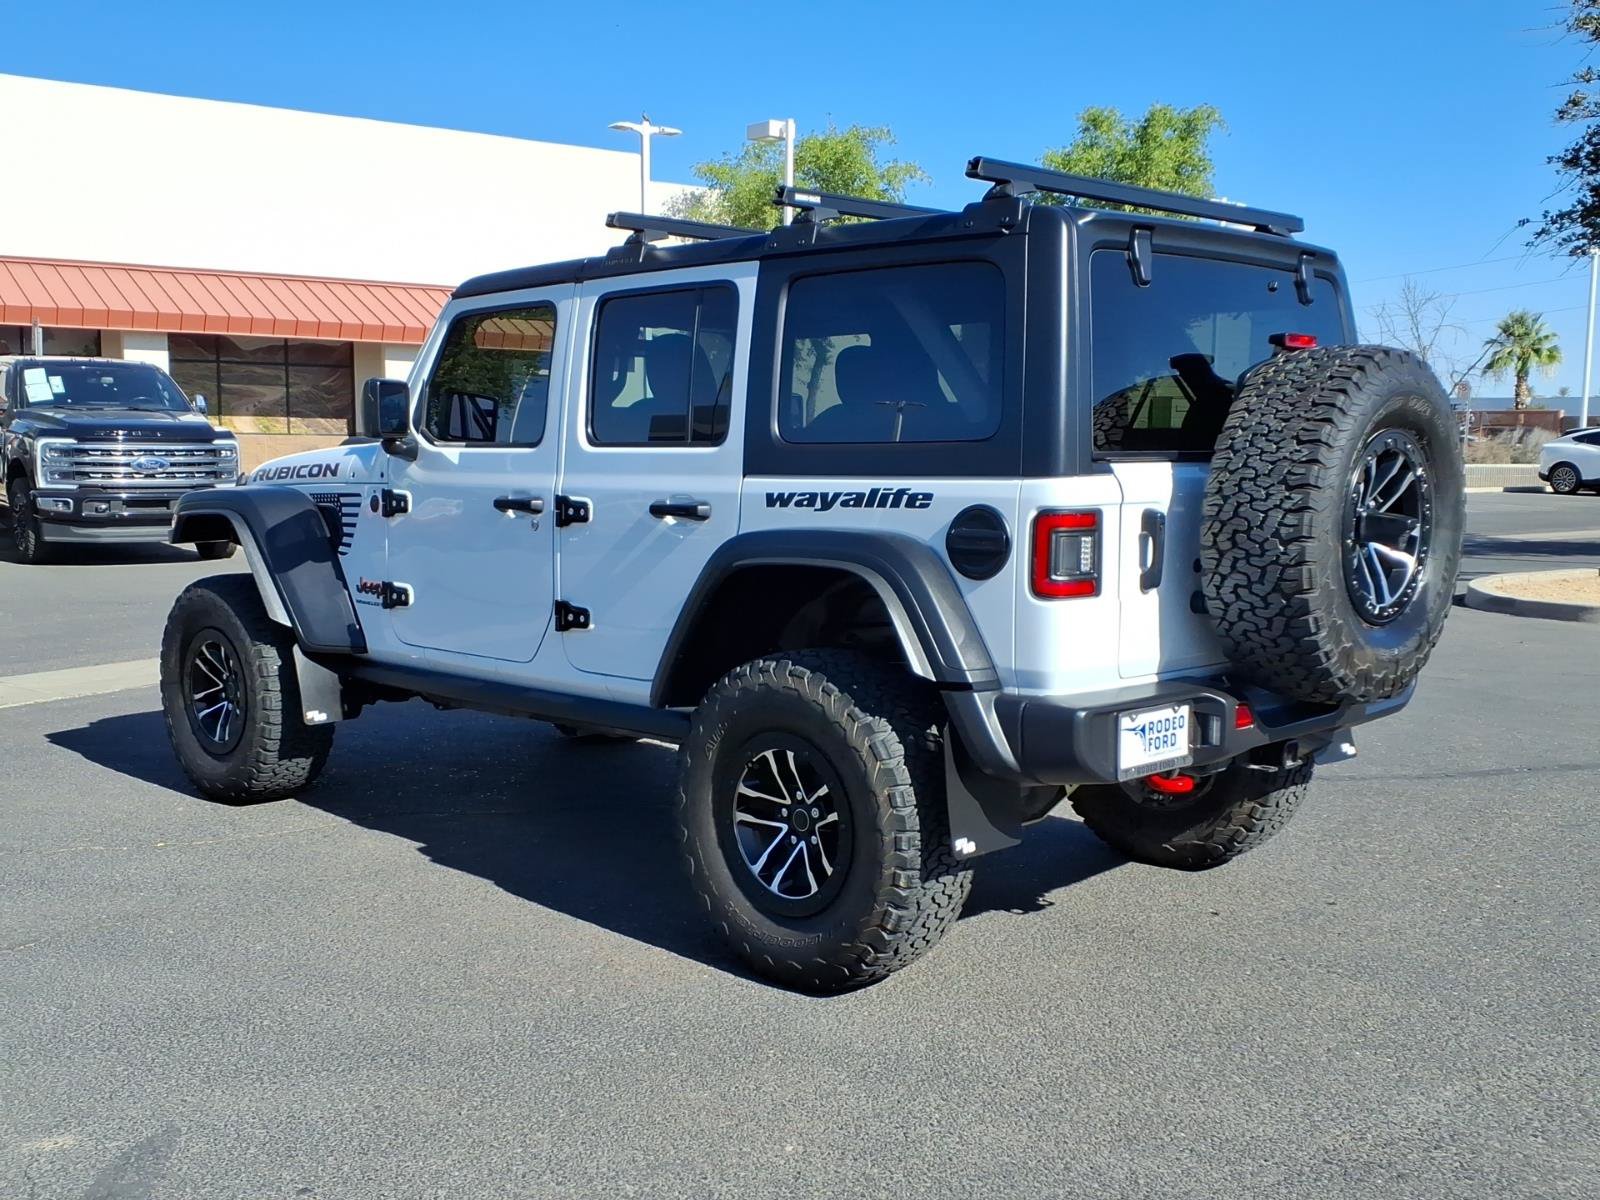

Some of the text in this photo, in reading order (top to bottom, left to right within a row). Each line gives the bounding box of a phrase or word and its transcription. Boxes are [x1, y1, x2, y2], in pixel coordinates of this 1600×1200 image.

[253, 462, 341, 482] RUBICON
[765, 487, 934, 512] wayalife
[1148, 715, 1185, 735] RODEO
[1148, 733, 1177, 753] FORD
